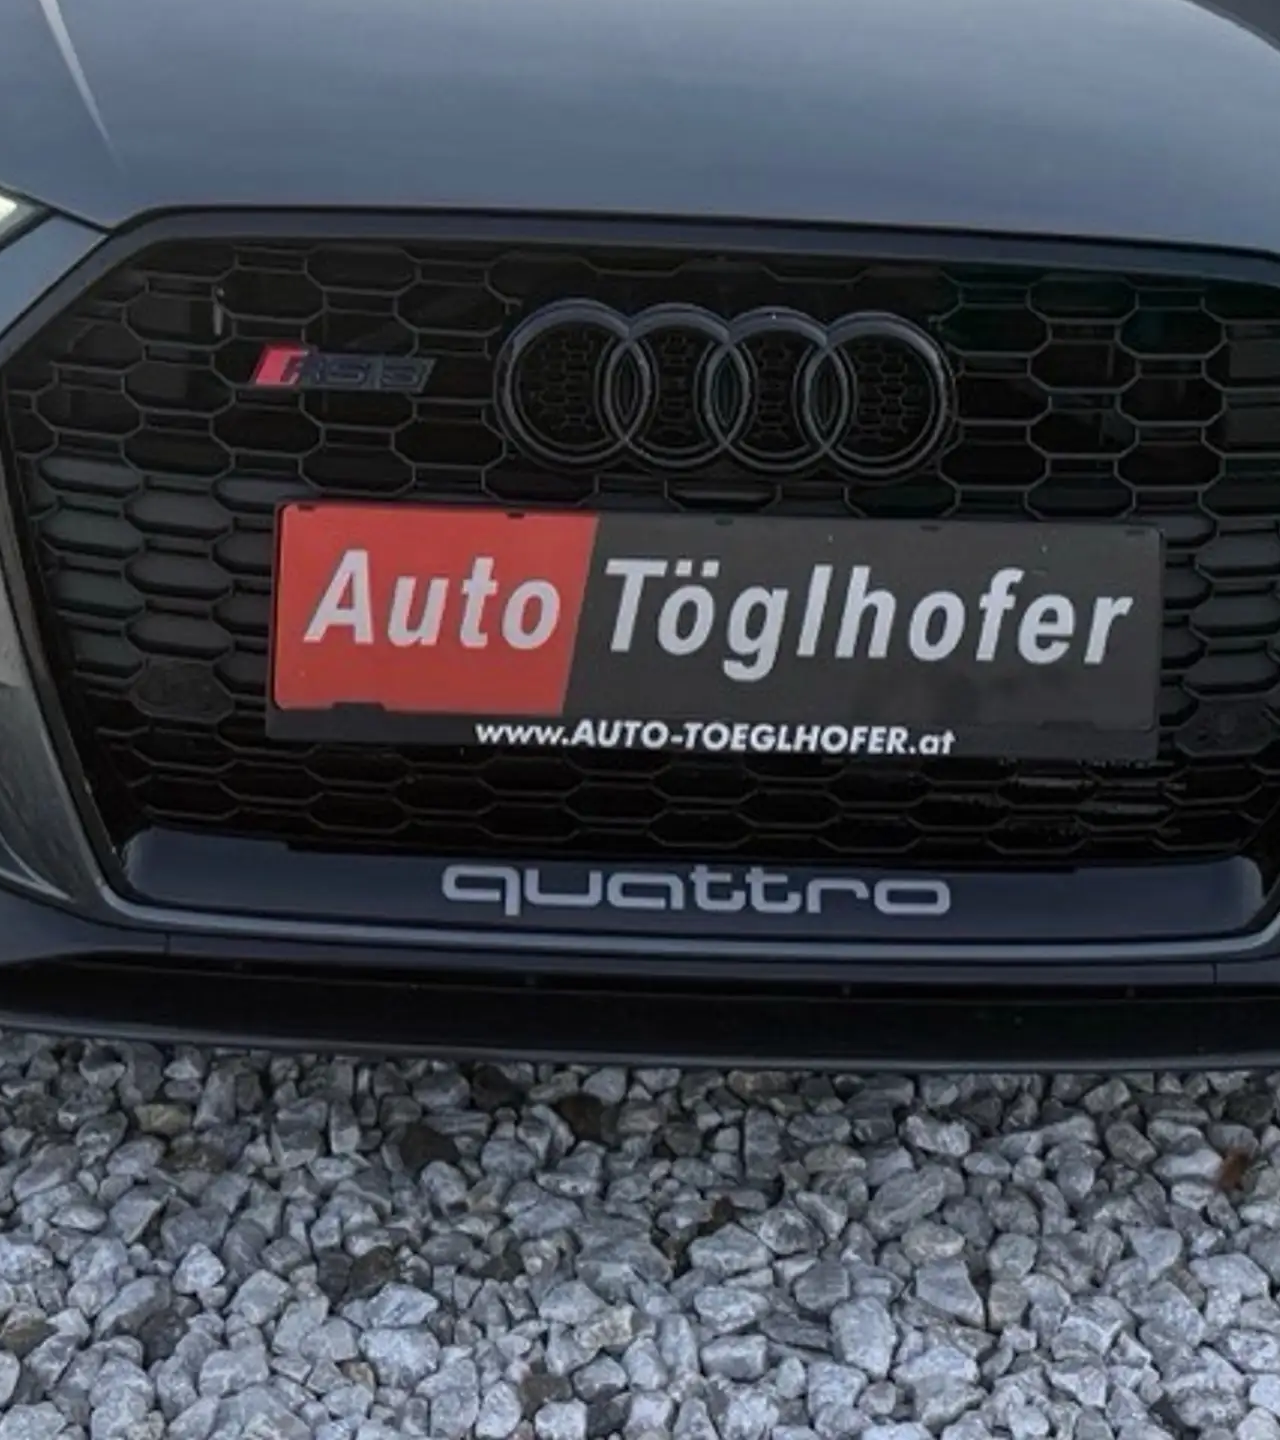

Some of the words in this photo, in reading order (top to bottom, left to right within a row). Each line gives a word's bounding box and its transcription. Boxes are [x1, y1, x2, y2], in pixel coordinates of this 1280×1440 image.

[304, 549, 562, 650] Auto
[604, 559, 1133, 680] Töglhofer
[477, 720, 956, 756] www.AUTO-TOEGLHOFER.at
[441, 864, 952, 915] quattro
